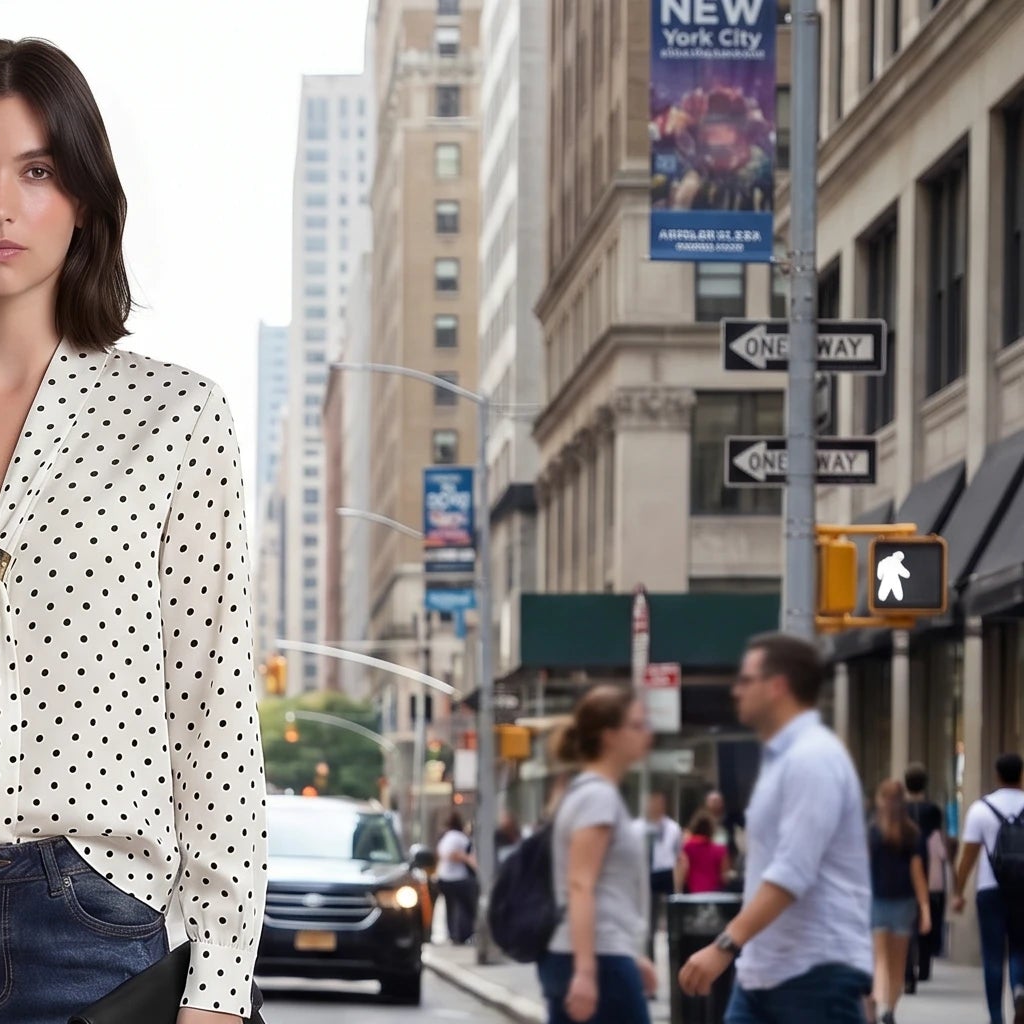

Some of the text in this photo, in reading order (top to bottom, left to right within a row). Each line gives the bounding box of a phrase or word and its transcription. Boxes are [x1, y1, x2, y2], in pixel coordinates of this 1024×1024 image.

[660, 0, 763, 26] NEW
[662, 27, 762, 51] York City
[745, 337, 862, 357] ONE WAY
[748, 451, 857, 472] ONE WAY
